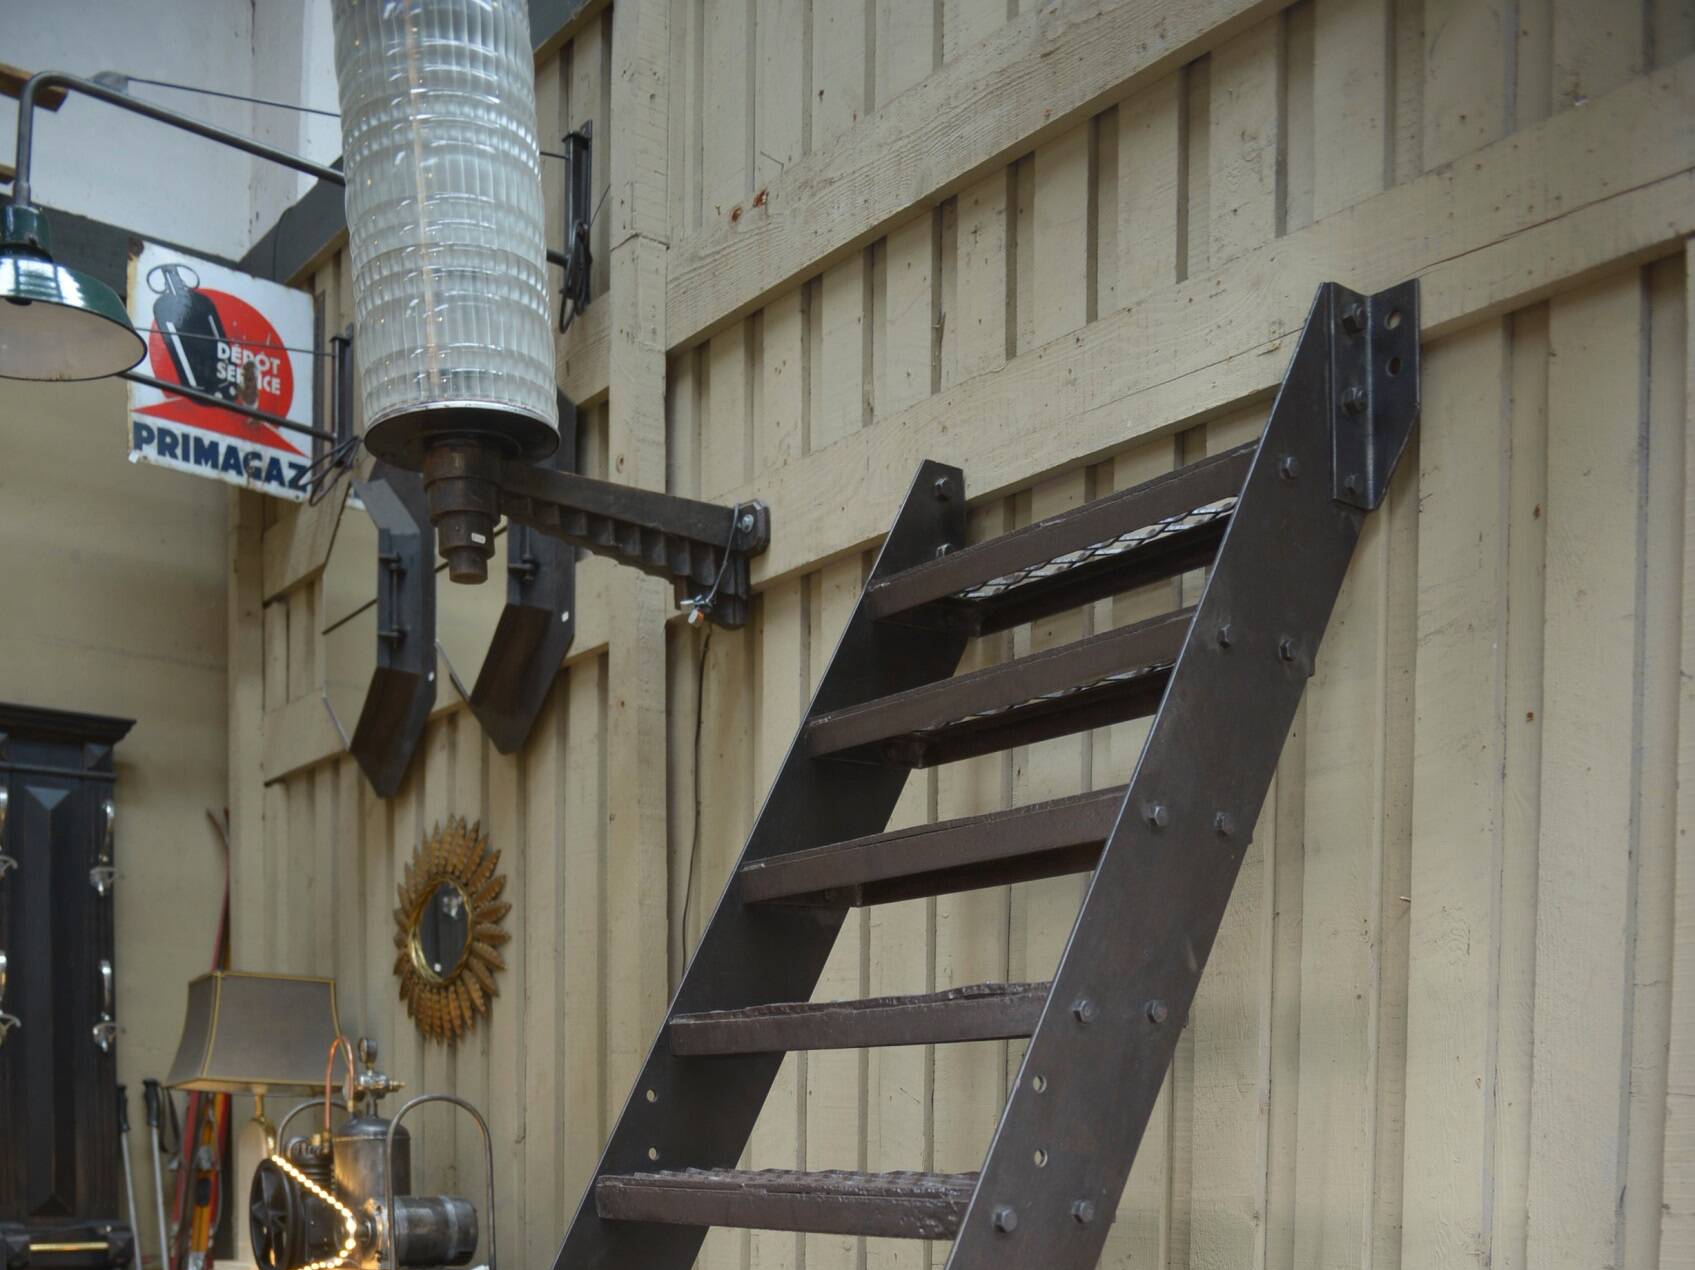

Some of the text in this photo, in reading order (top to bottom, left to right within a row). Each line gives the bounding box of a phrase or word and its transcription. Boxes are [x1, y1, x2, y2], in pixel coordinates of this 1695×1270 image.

[217, 341, 280, 375] DÉPÔT
[216, 361, 280, 395] SERICE
[133, 421, 308, 493] PRIMAGAZ
